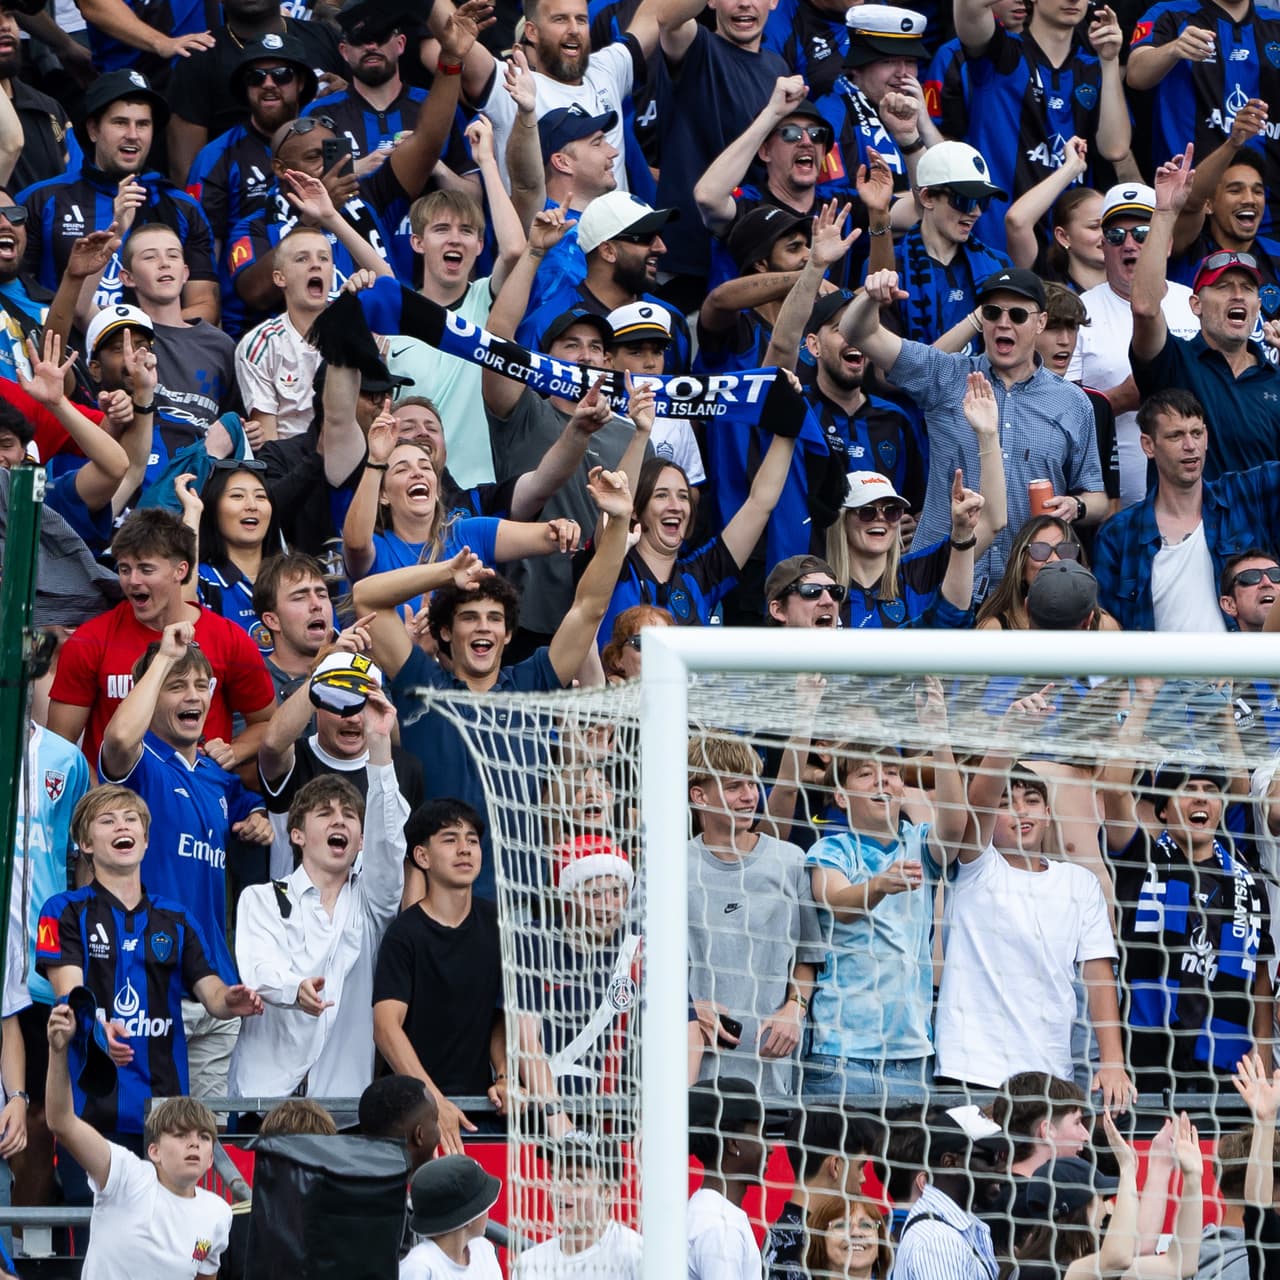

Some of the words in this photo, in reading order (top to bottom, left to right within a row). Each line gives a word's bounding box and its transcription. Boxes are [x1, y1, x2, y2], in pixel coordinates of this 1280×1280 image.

[472, 346, 504, 370] OUR
[506, 361, 545, 388] CITY,
[548, 376, 581, 399] OUR
[631, 373, 778, 405] PORT
[670, 400, 728, 417] ISLAND
[1232, 877, 1246, 939] ISLAND
